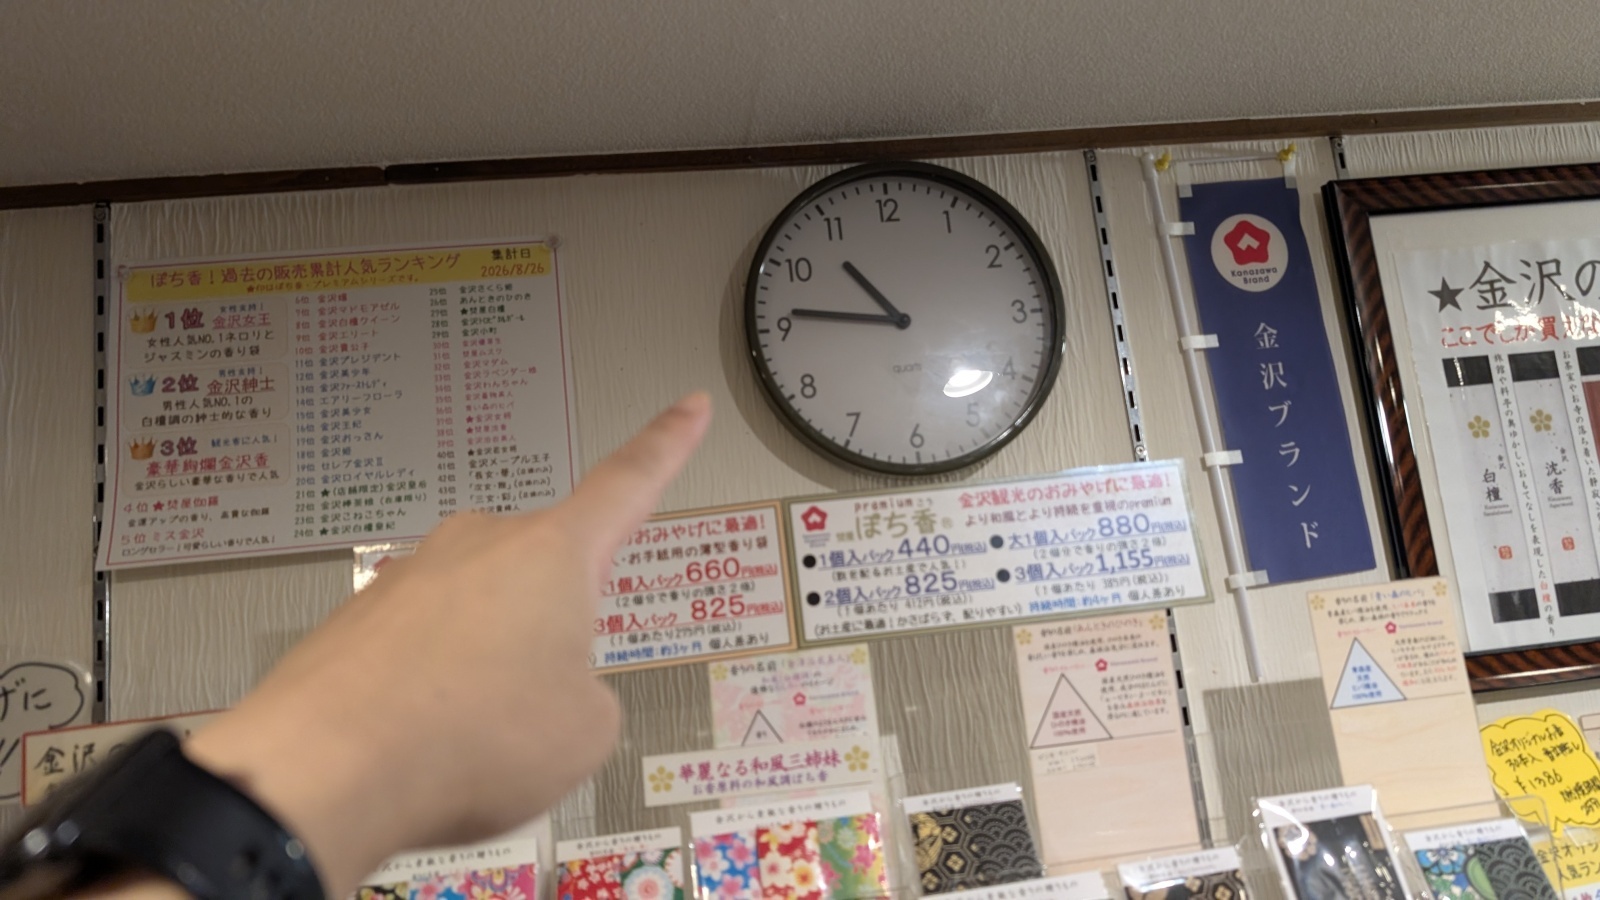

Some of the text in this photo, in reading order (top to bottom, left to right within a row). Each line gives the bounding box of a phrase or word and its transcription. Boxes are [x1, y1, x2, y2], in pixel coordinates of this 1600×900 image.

[876, 198, 900, 222] 12
[824, 217, 842, 240] 11
[943, 211, 951, 233] 1
[492, 248, 531, 261] 集計日
[985, 245, 1002, 268] 2
[481, 263, 544, 277] 2026/8/26
[785, 257, 812, 282] 10
[1231, 266, 1278, 278] Kanazawa
[1243, 275, 1270, 284] Brand
[165, 308, 205, 329] 1位
[212, 313, 271, 330] 金沢女王
[1011, 300, 1027, 323] 3
[777, 317, 792, 341] 9
[162, 374, 199, 392] 2位
[207, 377, 275, 396] 金沢紳士
[801, 373, 817, 398] 8
[846, 412, 861, 437] 7
[1254, 322, 1318, 549] 金沢ブランド
[160, 437, 198, 456] 3位
[910, 424, 924, 448] 6
[124, 501, 148, 513] 4位
[854, 497, 913, 513] premium
[628, 515, 765, 545] おみやげに最適!
[855, 508, 937, 541] ぽち香
[122, 533, 146, 545] 5位
